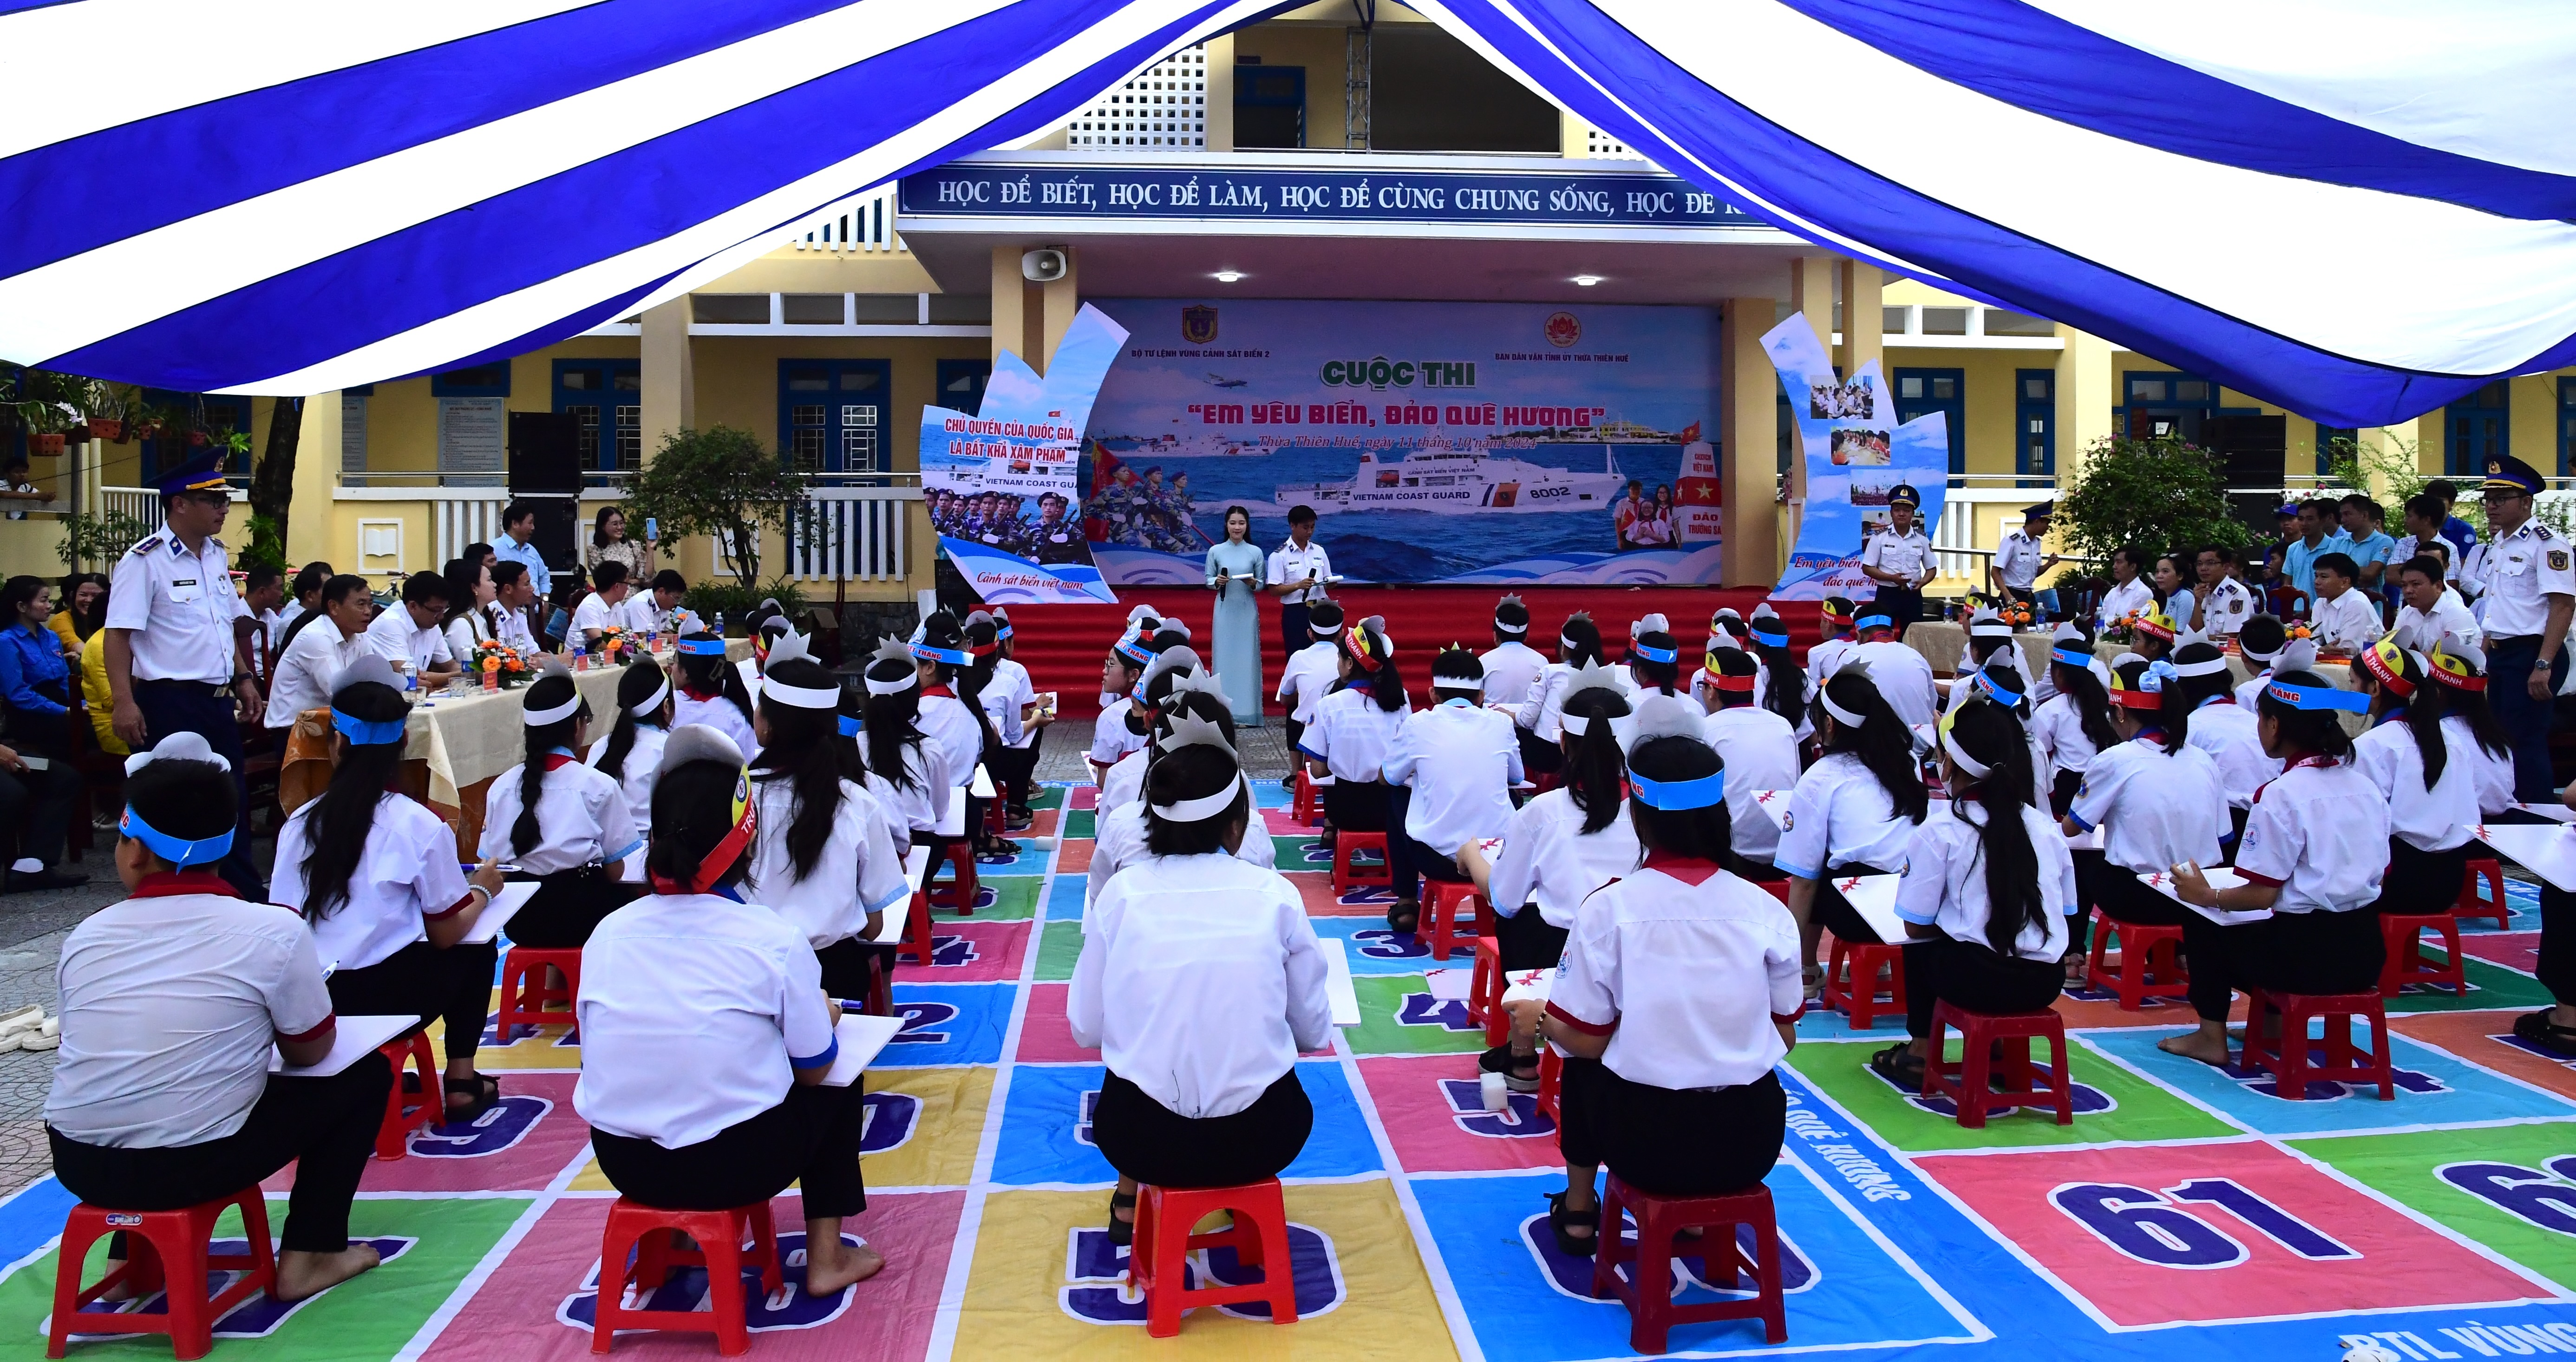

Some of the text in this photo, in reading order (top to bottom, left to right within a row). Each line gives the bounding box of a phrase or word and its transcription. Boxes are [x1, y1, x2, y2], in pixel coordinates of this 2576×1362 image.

[938, 180, 990, 207] HỌC
[1000, 174, 1032, 203] ĐỂ
[1041, 175, 1097, 210] BIẾT,
[1109, 183, 1160, 210] HỌC
[1170, 177, 1200, 207] ĐỂ
[1209, 179, 1268, 212] LÀM,
[1281, 186, 1330, 212] HỌC
[1340, 179, 1370, 209] ĐỂ
[1379, 182, 1445, 210] CÙNG
[1455, 188, 1540, 211] CHUNG
[1549, 183, 1615, 217] SỐNG,
[1626, 191, 1674, 218] HỌC
[1131, 350, 1142, 359] BỘ
[1157, 349, 1177, 358] LỆNH
[1179, 349, 1200, 357] VÙNG
[1203, 347, 1224, 357] CẢNH
[1227, 349, 1241, 357] SÁT
[1244, 348, 1262, 357] BIỂN
[1512, 352, 1527, 360] DÂN
[1529, 353, 1543, 362] VẬN
[1545, 351, 1561, 361] TỈNH
[1574, 353, 1591, 361] THỪA
[1594, 353, 1613, 361] THIÊN
[1615, 352, 1629, 362] HUẾ
[1321, 355, 1476, 391] CUỘC THI
[1251, 401, 1300, 425] YÊU
[1309, 399, 1376, 427] BIỂN,
[1384, 399, 1438, 426] ĐẢO
[1445, 403, 1497, 426] QUÊ
[945, 415, 1074, 441] CHỦ QUYỀN CỦA QUỐC GIA
[950, 439, 962, 455] LÀ
[965, 437, 983, 457] BẤT
[987, 440, 1007, 458] KHẢ
[1010, 443, 1033, 460] XÂM
[1258, 435, 1537, 451] Thừa Thiên Huế, ngày 11 tháng 10 năm 2024
[1530, 487, 1571, 498] 8002
[1693, 512, 1718, 521] ĐẢO
[1713, 525, 1721, 535] SA
[1795, 556, 1812, 568] Em
[1815, 558, 1835, 571] yêu
[977, 571, 1083, 590] Cảnh sát biển việt nam
[1823, 576, 1843, 586] đảo
[1846, 577, 1866, 589] quê
[2140, 621, 2153, 632] VINH
[2154, 628, 2171, 639] THANH
[1347, 637, 1363, 659] THANH
[2369, 657, 2393, 683] THANH
[2436, 669, 2463, 686] THANH
[1808, 1143, 1912, 1202] HƯƠNG
[2047, 1177, 2364, 1270] 61
[2437, 1320, 2576, 1356] VÙNG
